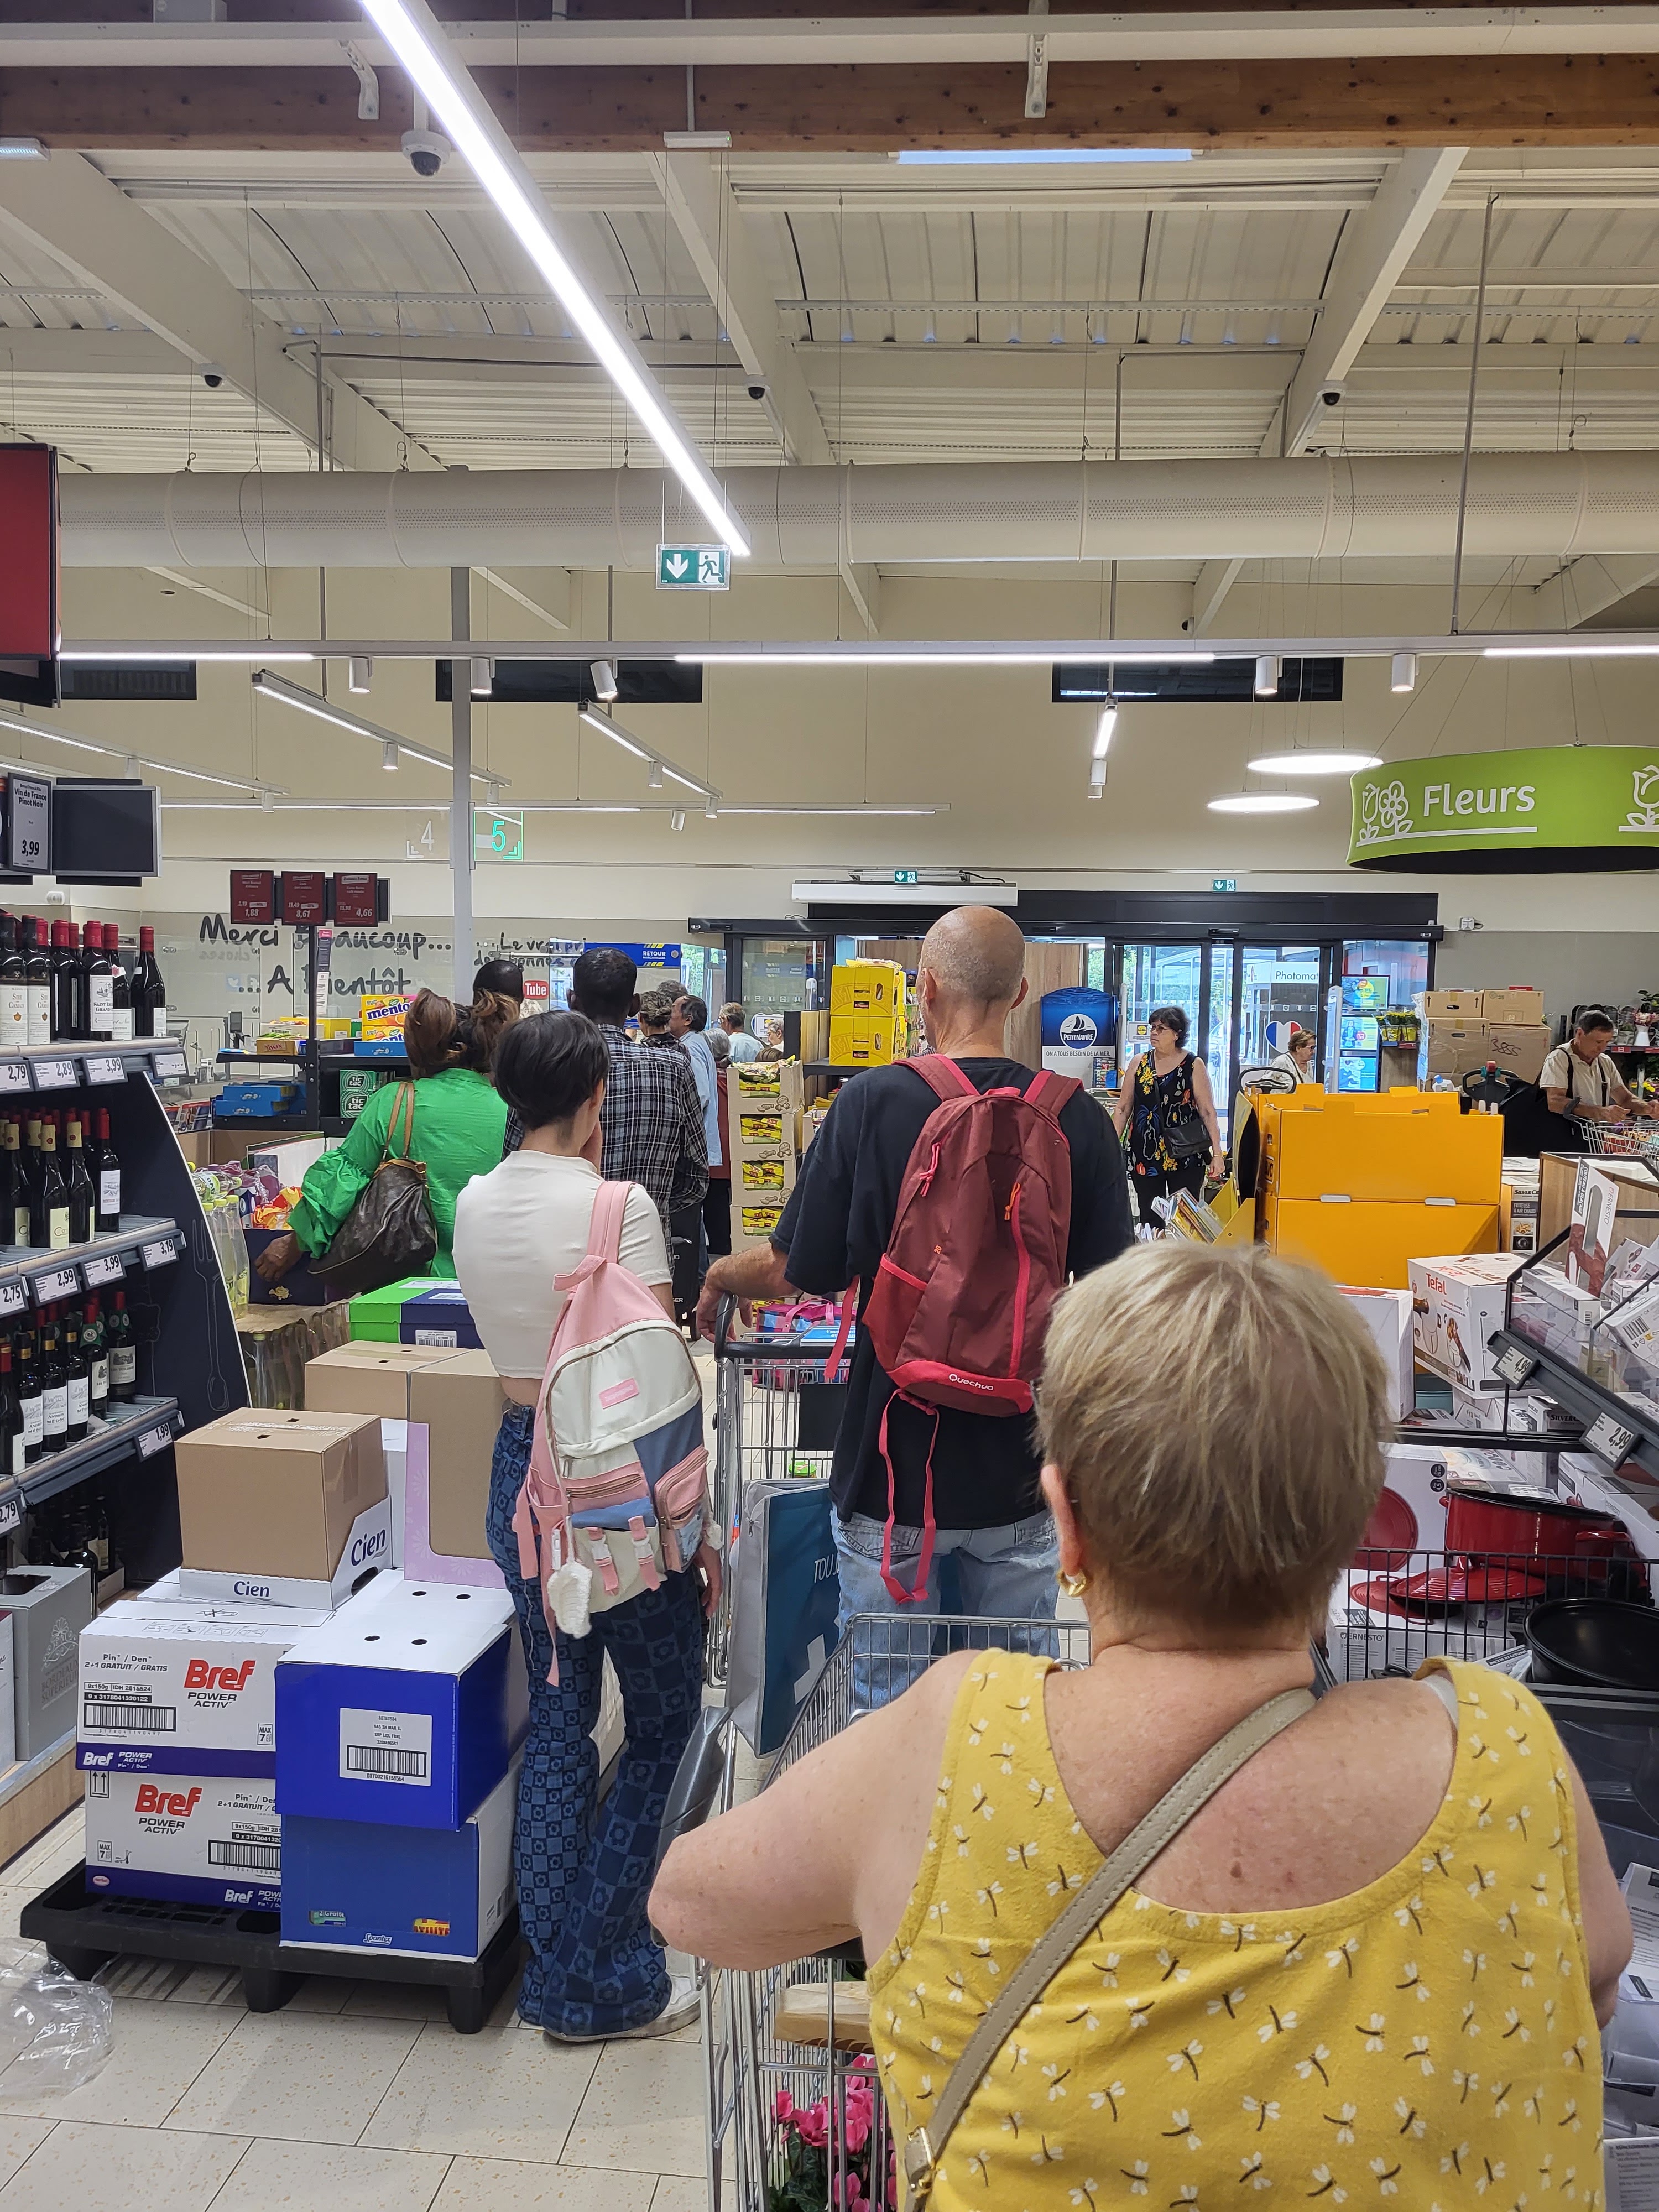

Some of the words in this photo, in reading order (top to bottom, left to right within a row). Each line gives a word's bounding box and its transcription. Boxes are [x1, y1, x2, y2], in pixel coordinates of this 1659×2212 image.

[14, 787, 23, 796] Vin
[31, 791, 47, 801] France
[19, 797, 32, 806] Pinot
[33, 800, 43, 808] Noir
[1423, 783, 1536, 817] Fleurs
[421, 820, 434, 851] 4
[491, 821, 505, 852] 5
[22, 839, 40, 857] 3,99
[200, 914, 278, 946] Merci
[525, 983, 547, 996] Tube
[367, 1003, 410, 1020] mento
[8, 1066, 26, 1082] 2,79
[56, 1062, 73, 1078] 2,89
[106, 1058, 121, 1074] 3,99
[160, 1239, 173, 1255] 3,19
[934, 1245, 942, 1254] 20
[103, 1255, 119, 1272] 3,99
[57, 1270, 74, 1287] 2,99
[1426, 1273, 1447, 1295] Tefal
[3, 1284, 20, 1302] 2,75
[1514, 1357, 1530, 1374] 4,99
[949, 1373, 994, 1391] Quechua
[155, 1422, 169, 1442] 1,99
[1608, 1427, 1631, 1450] 2,99
[351, 1528, 385, 1567] Cien
[233, 1580, 270, 1598] Cien
[101, 1662, 132, 1671] GRATUIT
[184, 1659, 256, 1691] Bref
[187, 1692, 237, 1702] POWER
[259, 1734, 265, 1742] 7
[83, 1752, 114, 1766] Bref
[134, 1783, 203, 1817] Bref
[233, 1802, 264, 1811] GRATUIT
[138, 1817, 185, 1829] POWER
[224, 1889, 254, 1904] Bref
[364, 1933, 392, 1944] Spontex
